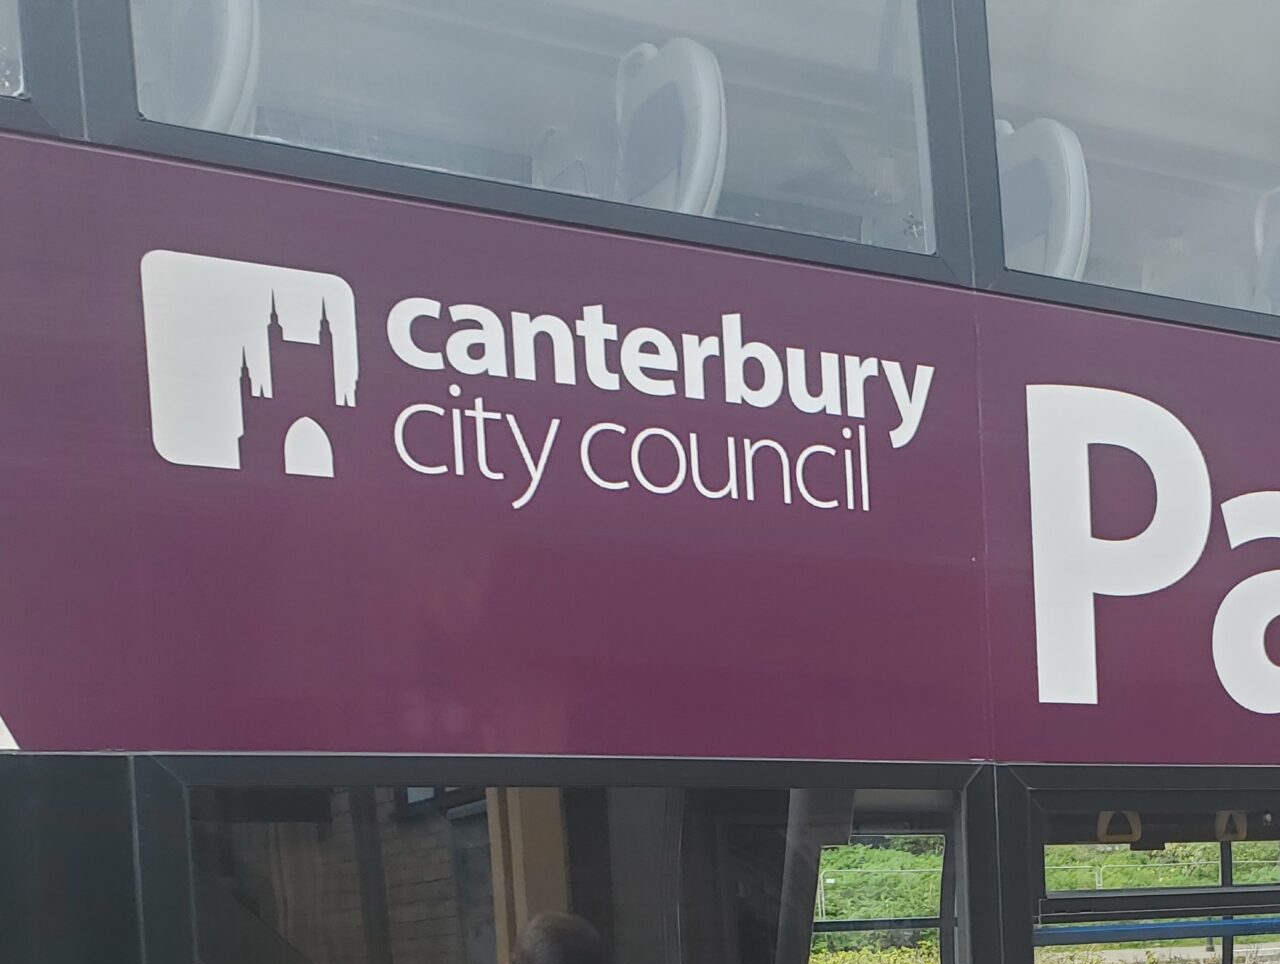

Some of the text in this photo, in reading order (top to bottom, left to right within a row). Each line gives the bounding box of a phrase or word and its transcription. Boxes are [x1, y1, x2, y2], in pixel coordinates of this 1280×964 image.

[386, 296, 935, 449] canterbury
[393, 383, 870, 512] city council
